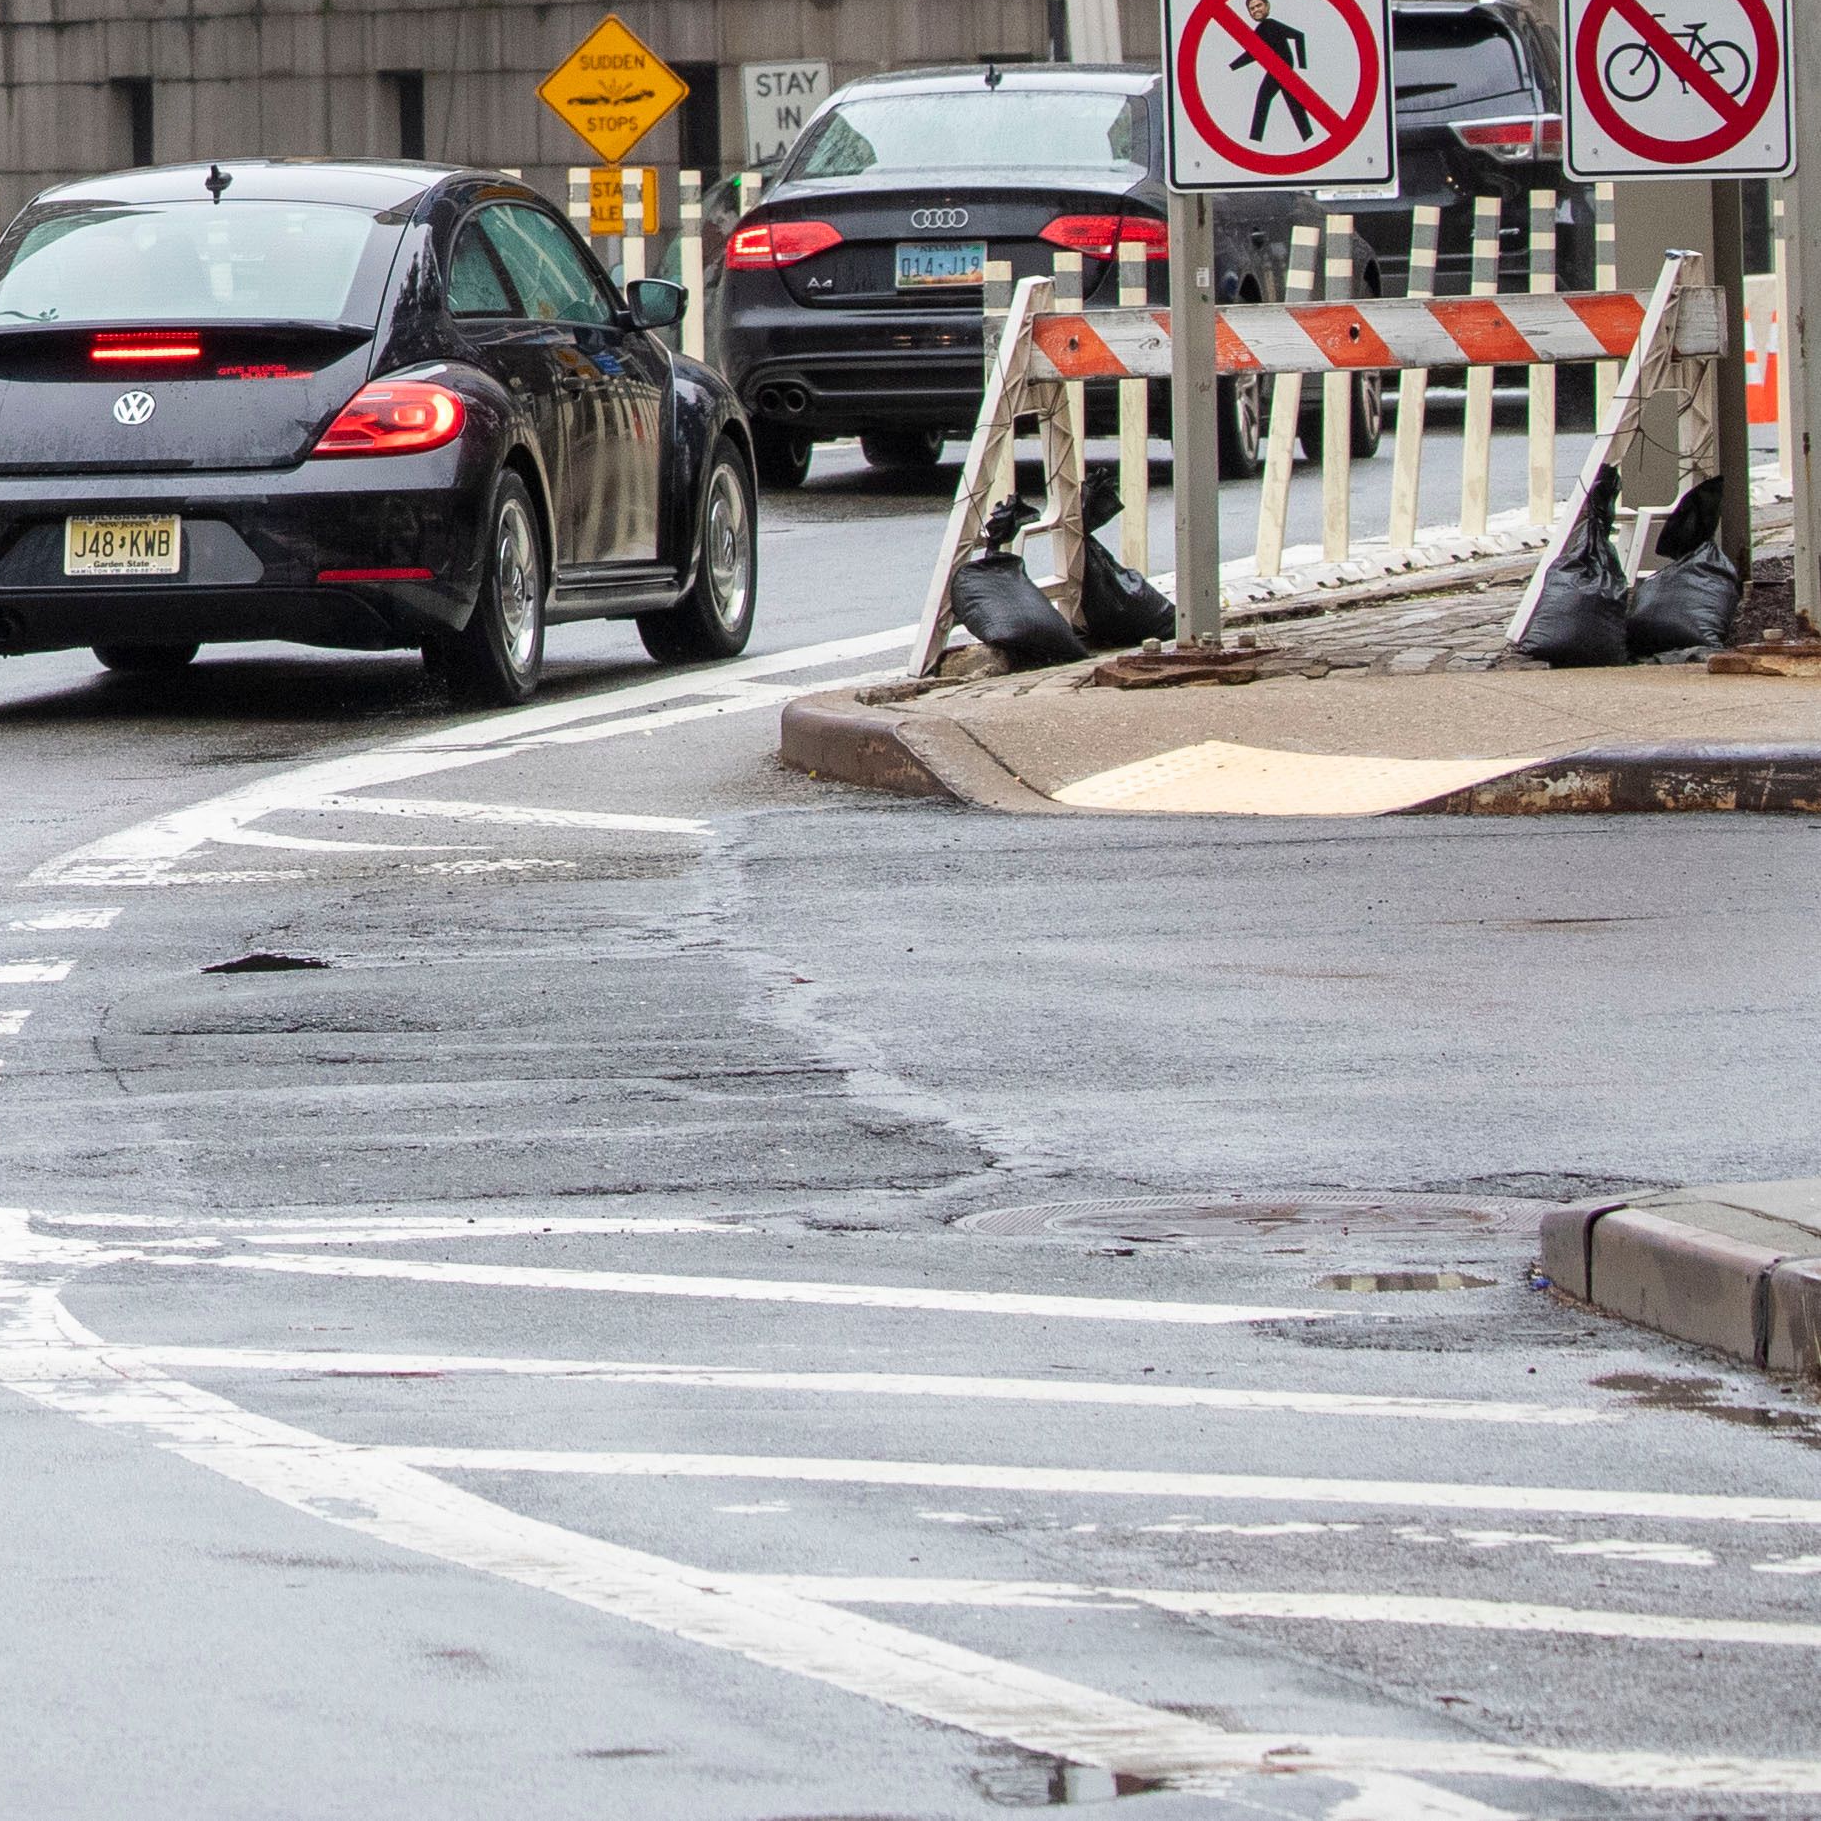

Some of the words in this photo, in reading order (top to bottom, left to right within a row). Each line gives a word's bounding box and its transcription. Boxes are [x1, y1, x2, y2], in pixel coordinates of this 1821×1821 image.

[579, 54, 646, 71] SUDDEN
[757, 70, 819, 98] STAY
[587, 116, 639, 132] STOPS
[777, 106, 802, 130] IN
[592, 182, 622, 198] STA
[807, 277, 833, 289] A4
